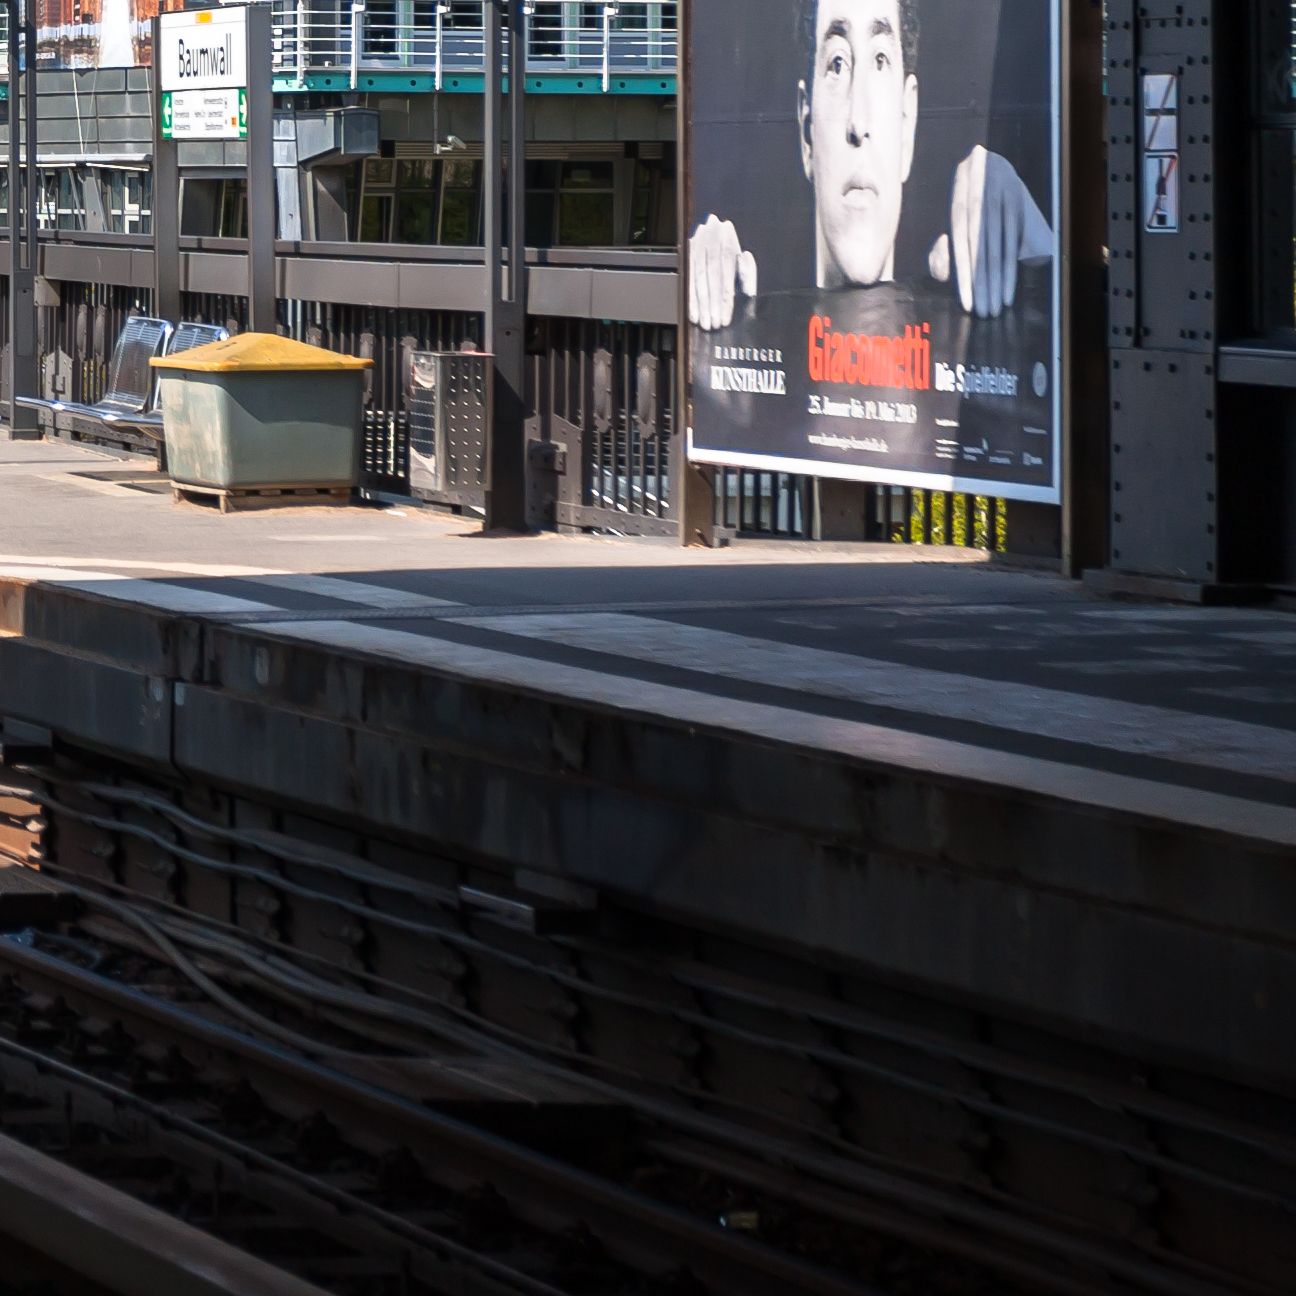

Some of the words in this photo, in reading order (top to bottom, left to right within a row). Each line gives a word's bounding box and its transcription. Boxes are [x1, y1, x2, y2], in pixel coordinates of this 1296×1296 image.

[178, 33, 231, 78] Baumwall
[714, 345, 783, 363] HAMBURGER
[808, 314, 931, 391] Giacometti
[710, 365, 786, 395] KUNSTHALLE
